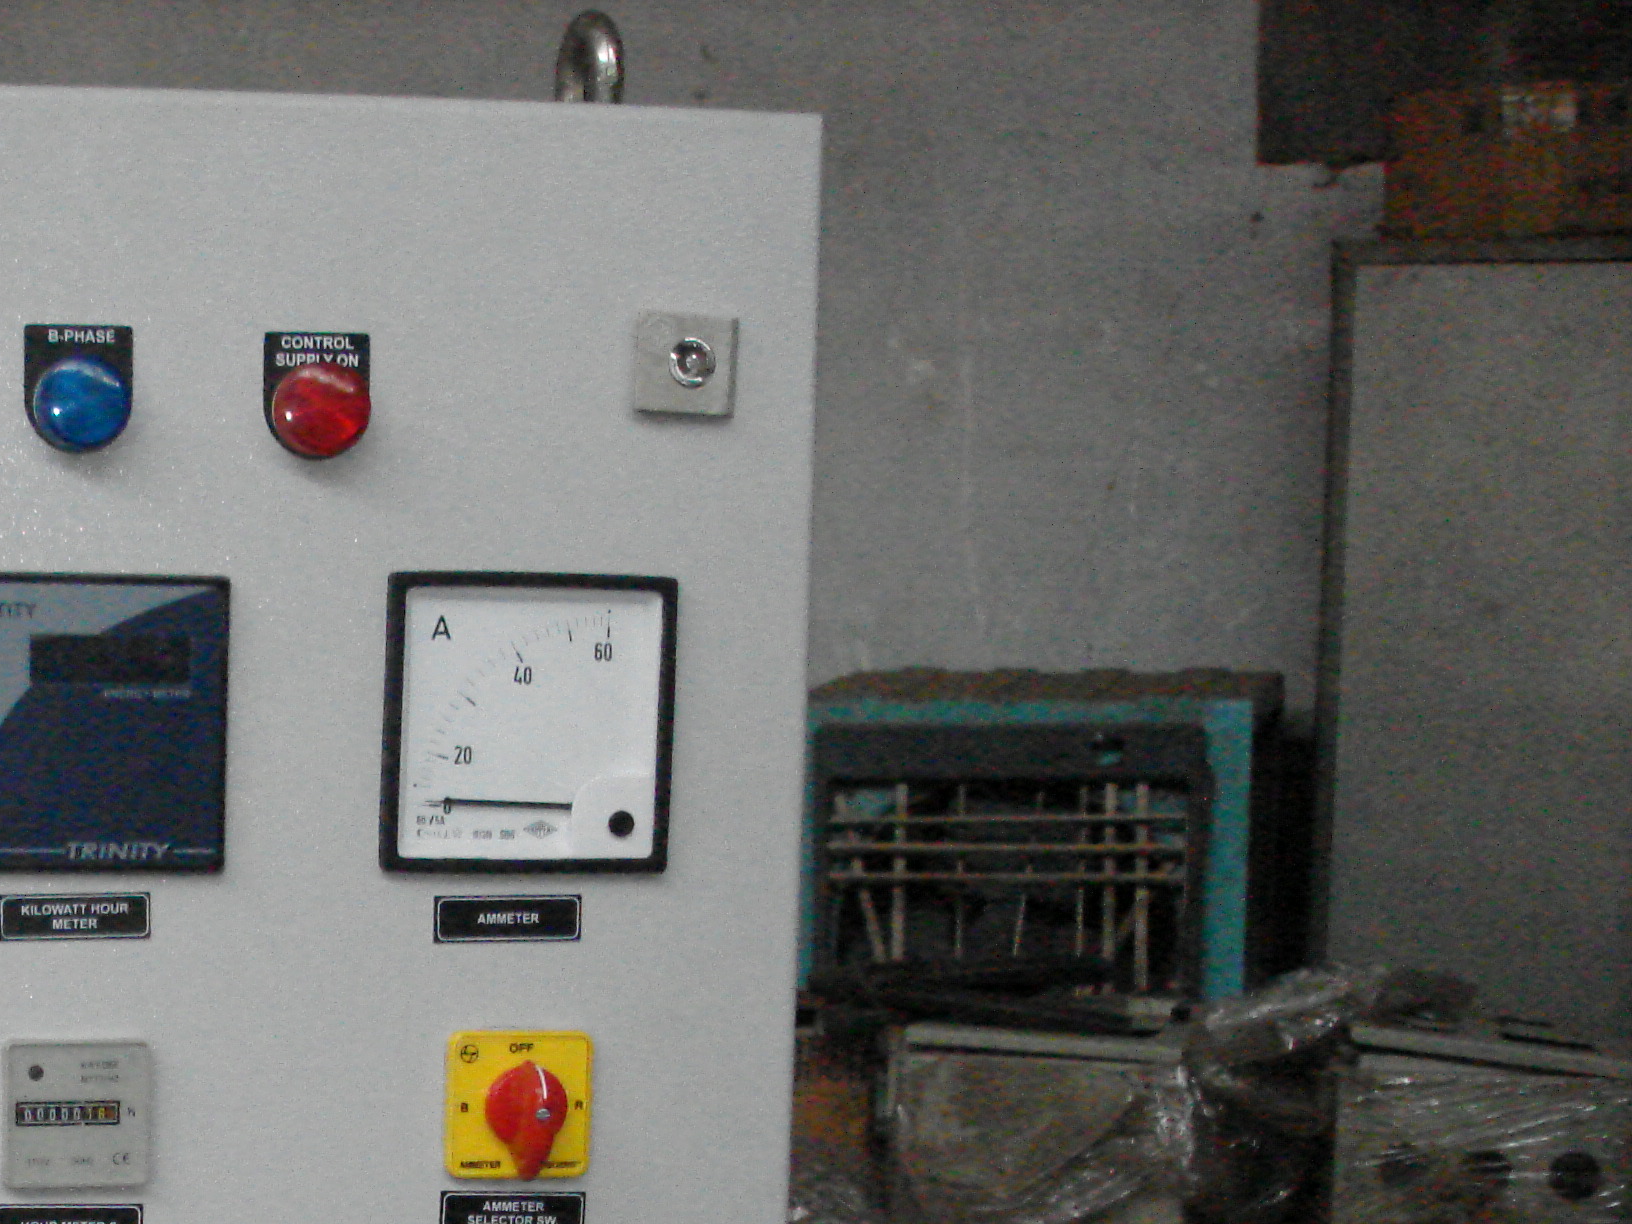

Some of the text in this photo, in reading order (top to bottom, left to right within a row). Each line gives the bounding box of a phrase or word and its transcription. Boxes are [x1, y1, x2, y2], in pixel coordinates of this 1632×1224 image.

[48, 328, 115, 344] B-PHASE
[281, 336, 355, 350] CONTROL
[337, 353, 358, 367] ON
[431, 615, 451, 641] A
[594, 643, 613, 662] 60
[513, 666, 532, 686] 40
[454, 746, 472, 765] 20
[67, 842, 170, 860] TRINITY
[20, 902, 129, 916] KILOWATT HOUR
[52, 918, 98, 930] METER
[477, 912, 540, 925] AMMETER
[509, 1043, 534, 1054] OFF
[483, 1201, 544, 1212] AMMETER
